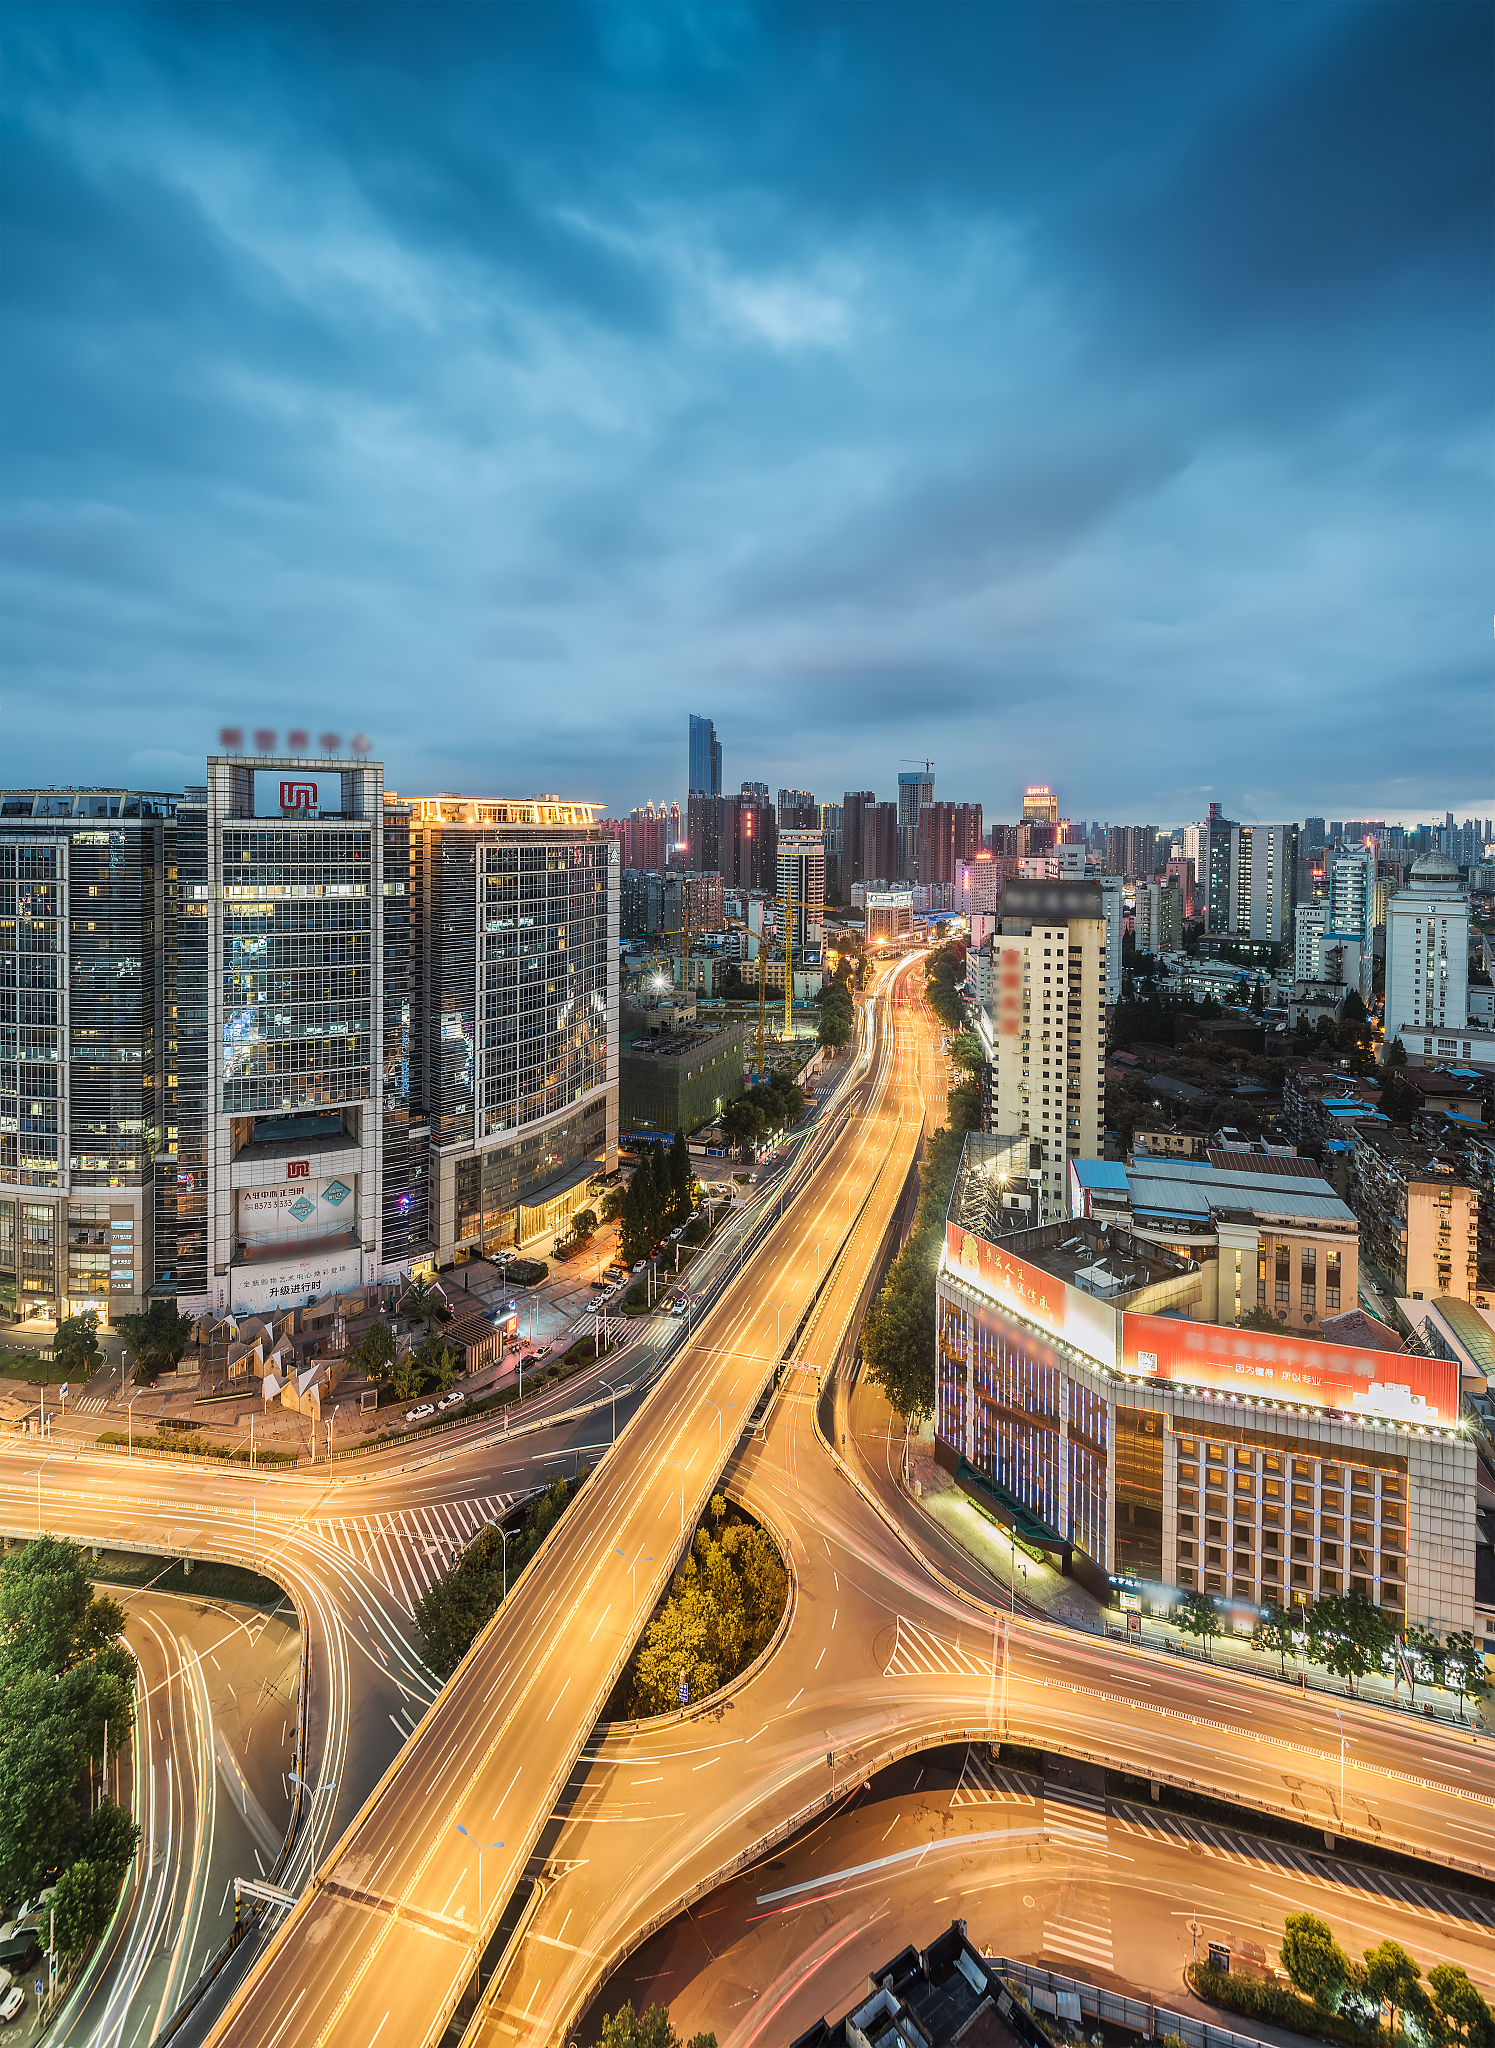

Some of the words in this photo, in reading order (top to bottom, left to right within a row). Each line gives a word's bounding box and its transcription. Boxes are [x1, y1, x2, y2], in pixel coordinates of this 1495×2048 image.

[269, 1280, 322, 1297] 升级进行时
[1235, 1363, 1274, 1379] 因为懂得
[1281, 1371, 1322, 1386] 所以专业
